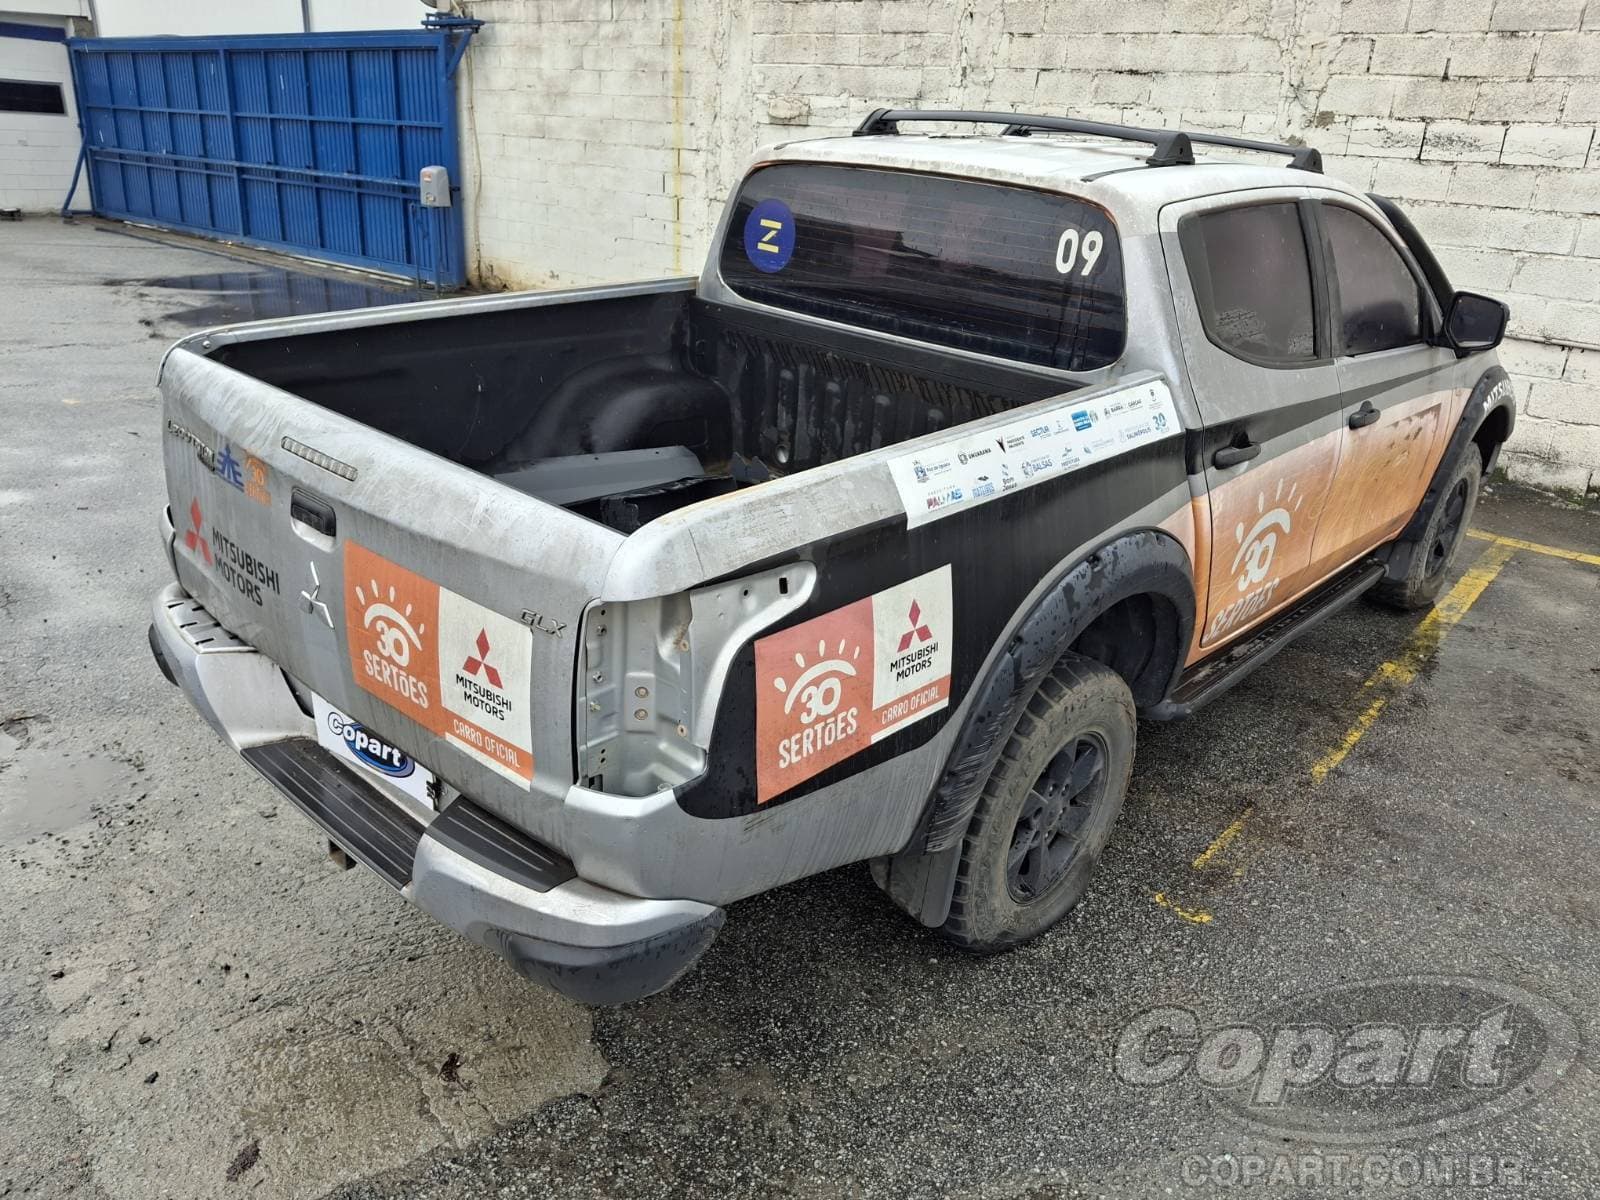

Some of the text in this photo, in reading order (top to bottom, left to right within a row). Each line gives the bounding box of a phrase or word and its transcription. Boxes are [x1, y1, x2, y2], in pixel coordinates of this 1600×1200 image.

[1055, 228, 1103, 276] 09
[211, 527, 281, 594] MITSUBISHI
[214, 555, 263, 606] MOTORS
[1238, 532, 1277, 592] 30
[375, 619, 410, 668] 30
[519, 608, 567, 638] GLX
[363, 650, 429, 710] SERTÕES
[890, 641, 939, 673] MITSUBISHI
[896, 656, 932, 682] MOTORS
[455, 674, 512, 712] MITSUBISHI
[464, 690, 506, 721] MOTORS
[800, 677, 842, 724] 30
[881, 685, 940, 725] CARRO OFICIAL
[328, 711, 401, 767] Copart
[453, 718, 521, 768] CARRO OFICIAL
[778, 706, 858, 769] SERTÕES
